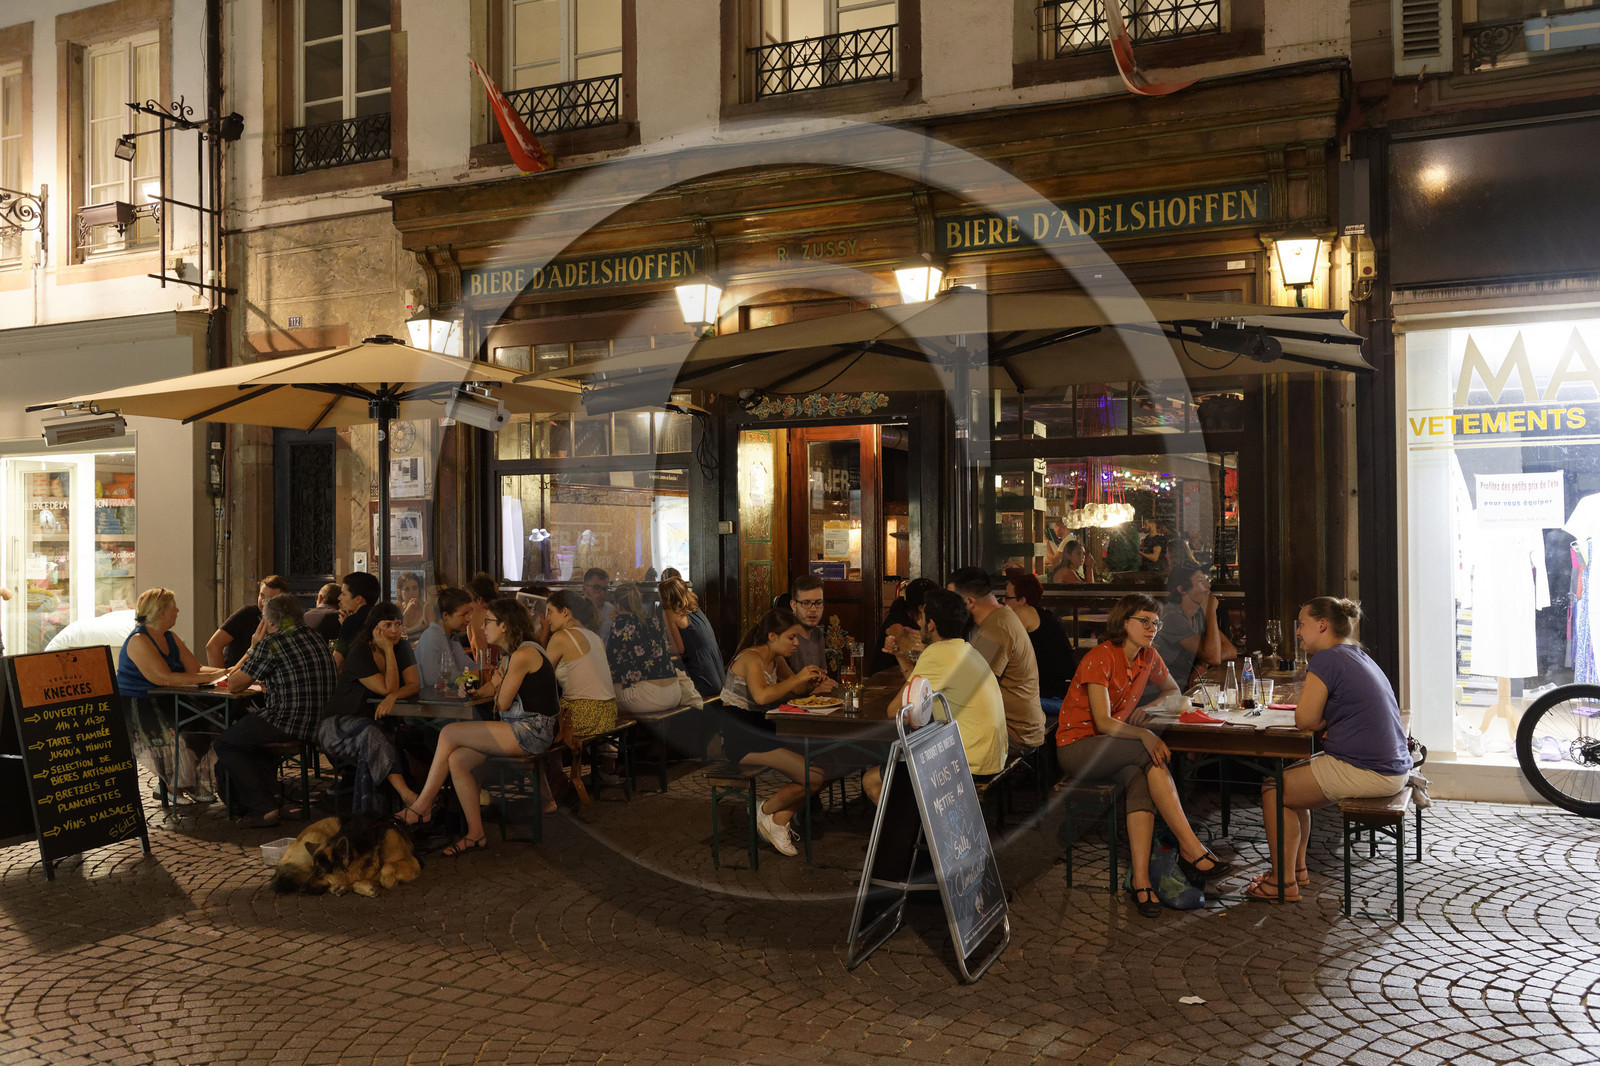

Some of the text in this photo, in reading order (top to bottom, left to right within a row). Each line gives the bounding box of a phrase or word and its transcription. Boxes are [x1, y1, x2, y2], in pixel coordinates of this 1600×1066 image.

[946, 189, 1258, 249] BIERE D'ADELSHOFFEN
[801, 239, 857, 260] ZUSSY
[470, 249, 697, 296] BIERE D'ADELSHOFFEN
[290, 317, 300, 326] 112
[1453, 325, 1600, 406] MA
[1409, 407, 1587, 437] VETEMENTS
[1480, 481, 1500, 491] Profitez
[1501, 480, 1510, 491] des
[1511, 480, 1527, 493] petits
[1528, 480, 1538, 492] prix
[1539, 480, 1546, 490] de
[49, 674, 83, 683] TROQUET
[43, 682, 93, 700] KNECKES
[43, 702, 111, 720] OUVERT 7/7 DE
[85, 715, 106, 727] 1h30
[46, 735, 73, 748] TARTE
[99, 754, 112, 764] DE
[950, 759, 961, 775] TE
[55, 776, 117, 801] BRETZELS ET
[57, 788, 122, 814] PLANCHETTES
[933, 781, 964, 817] METTRE AU
[89, 803, 135, 824] D'ALSACE
